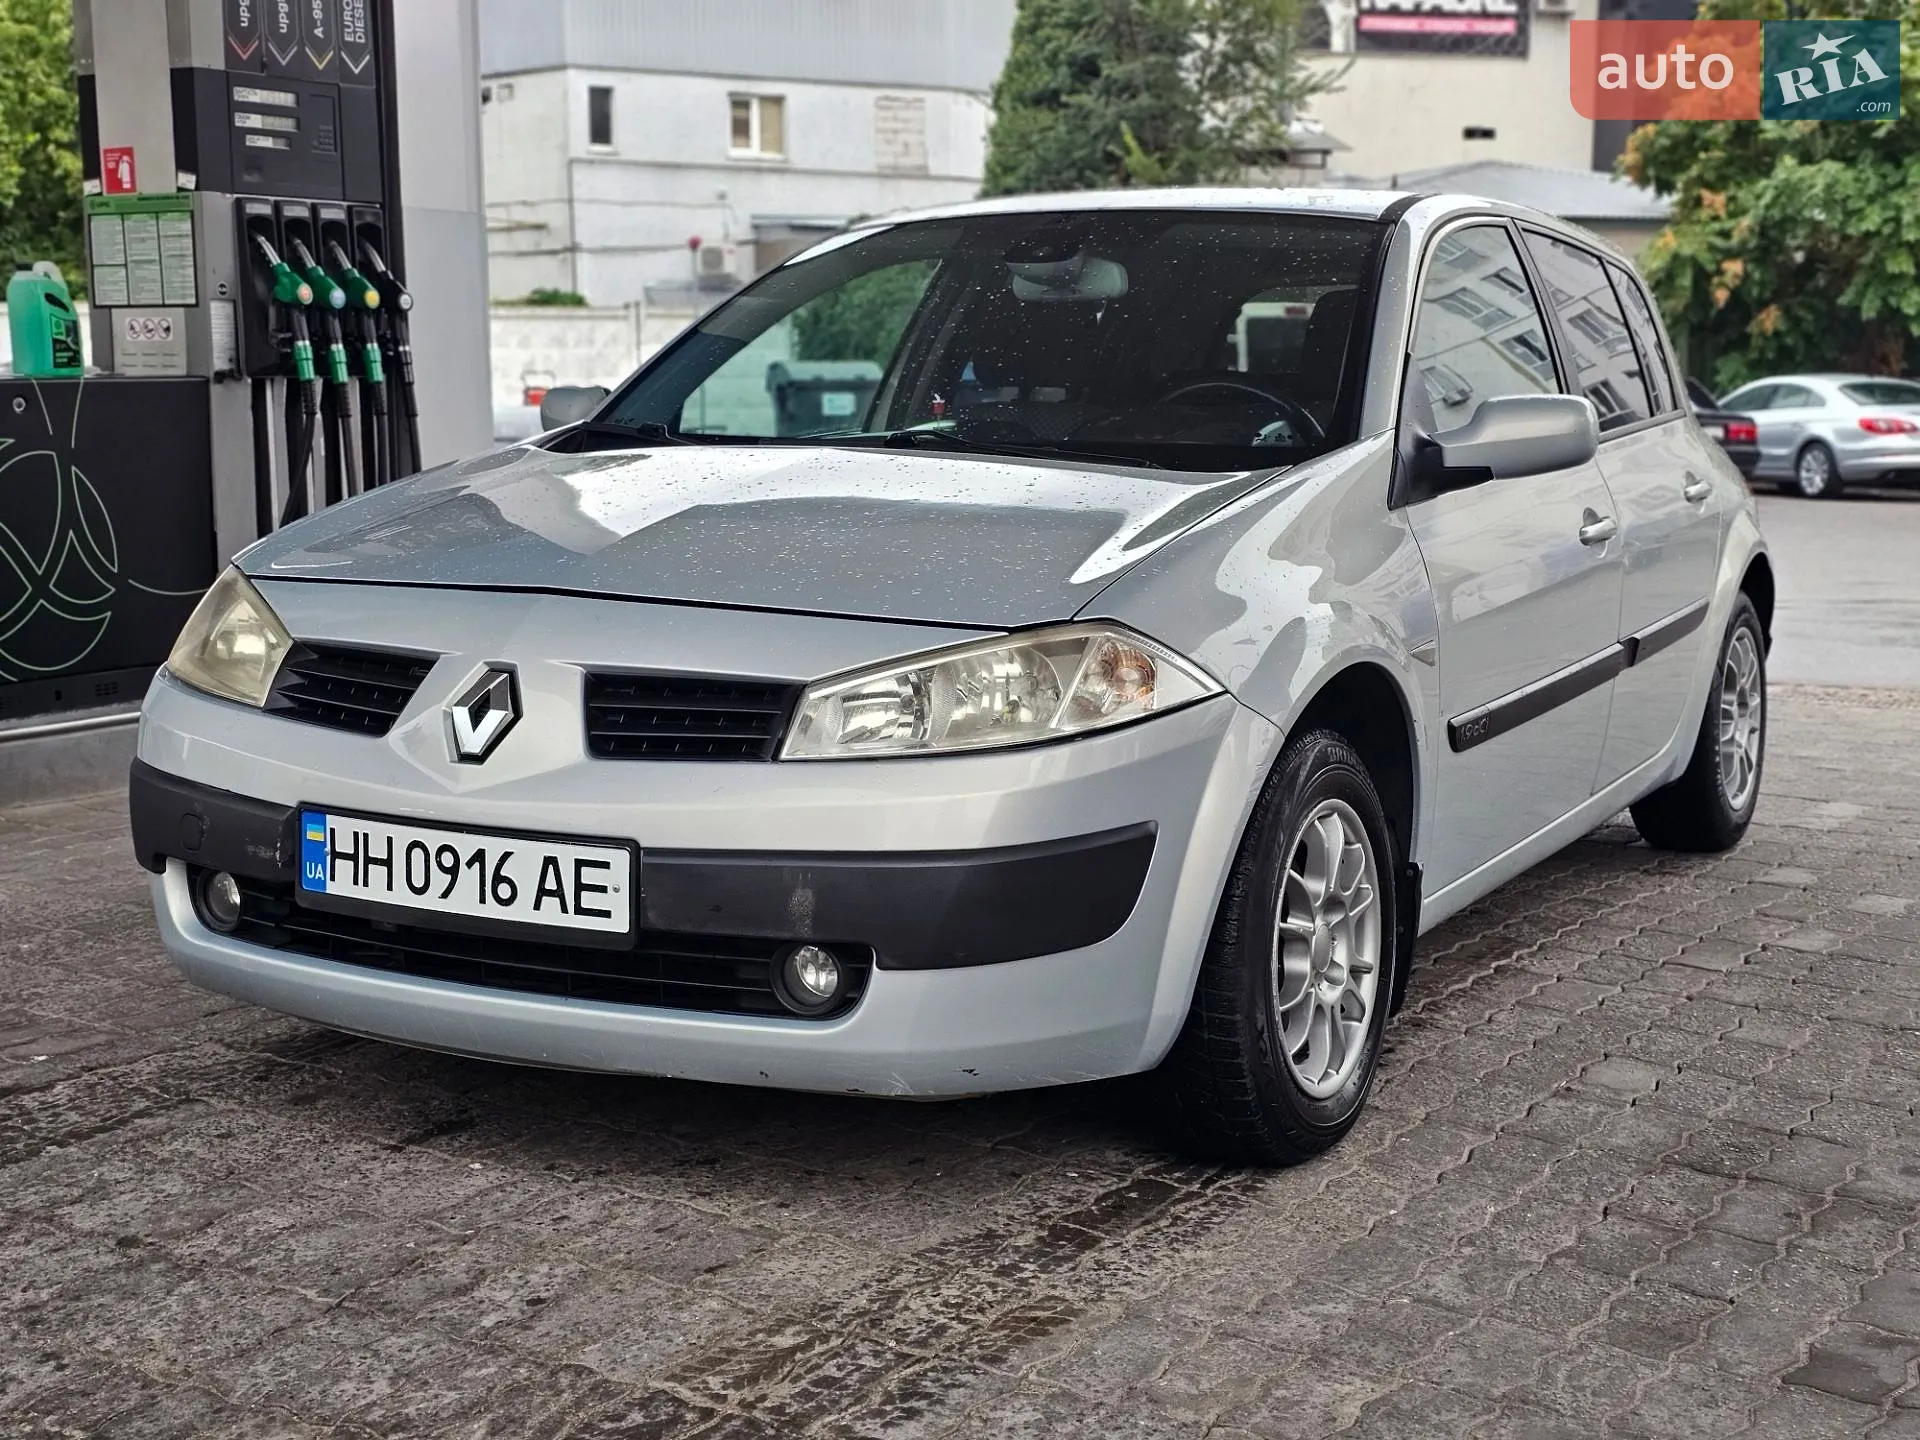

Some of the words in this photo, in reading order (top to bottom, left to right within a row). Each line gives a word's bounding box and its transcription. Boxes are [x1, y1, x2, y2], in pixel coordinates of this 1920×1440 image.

[277, 0, 289, 33] upg
[312, 0, 325, 39] A-95
[343, 0, 354, 41] EURO
[306, 861, 325, 881] UA
[329, 827, 394, 892] HH
[405, 839, 518, 907] 0916
[532, 855, 612, 919] AE
